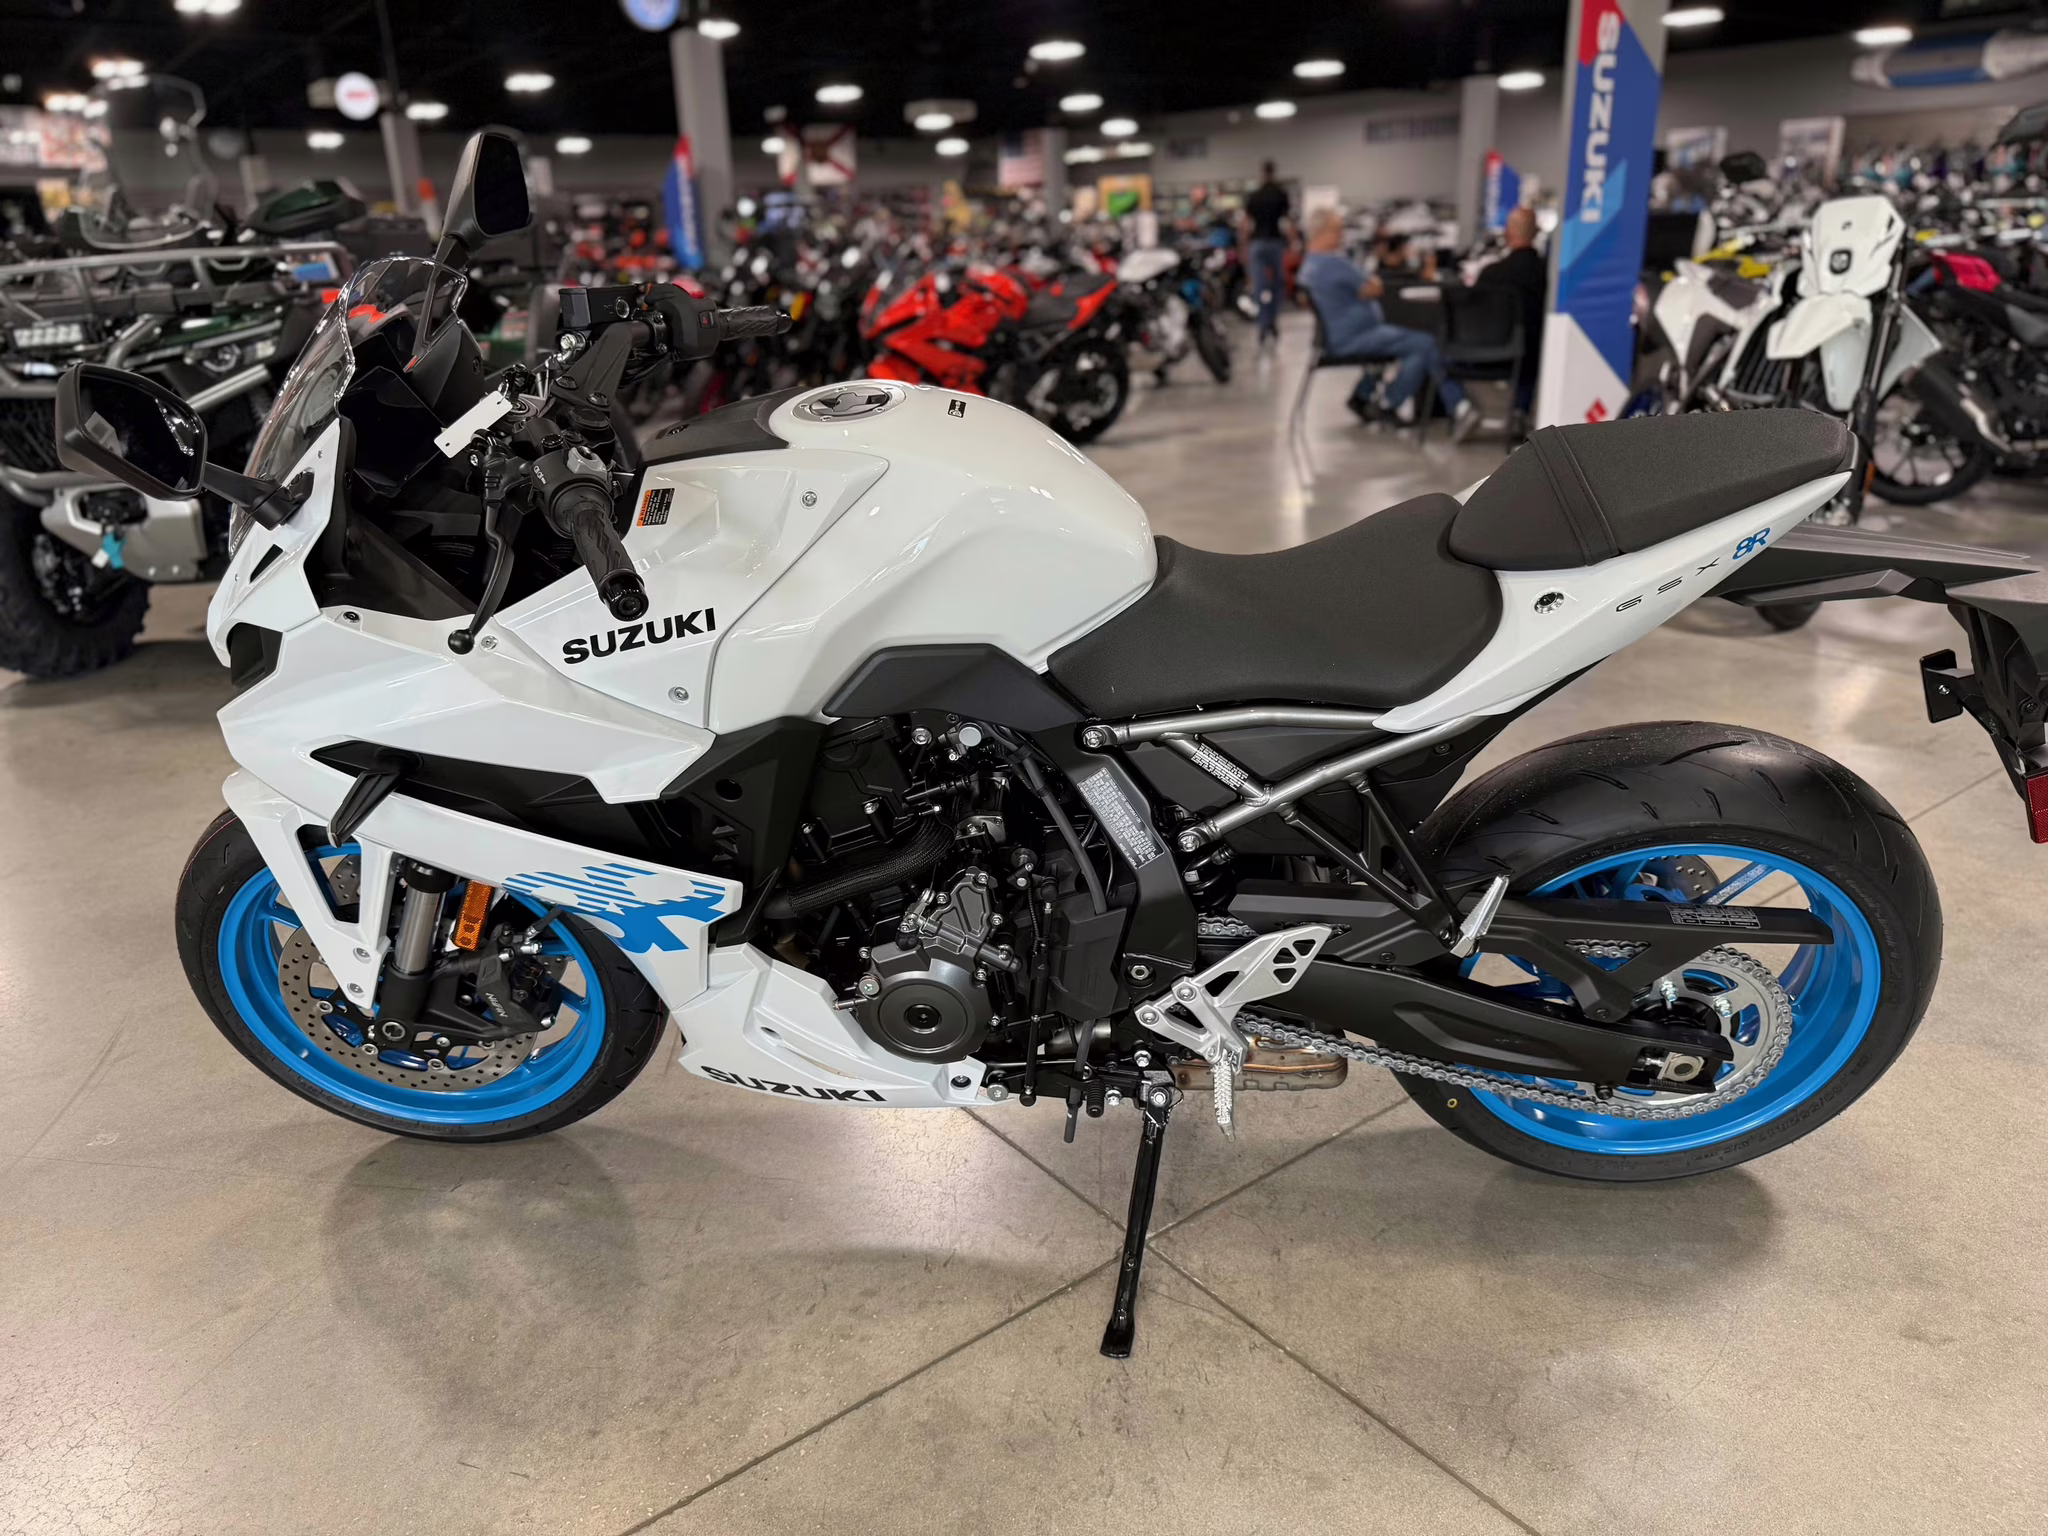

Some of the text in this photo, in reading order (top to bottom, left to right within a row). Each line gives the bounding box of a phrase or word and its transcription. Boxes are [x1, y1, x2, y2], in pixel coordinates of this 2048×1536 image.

[1580, 11, 1621, 223] SUZUKI
[1616, 527, 1771, 612] GSX 8R
[562, 607, 716, 664] SUZUKI
[700, 1065, 887, 1102] SUZUKI
